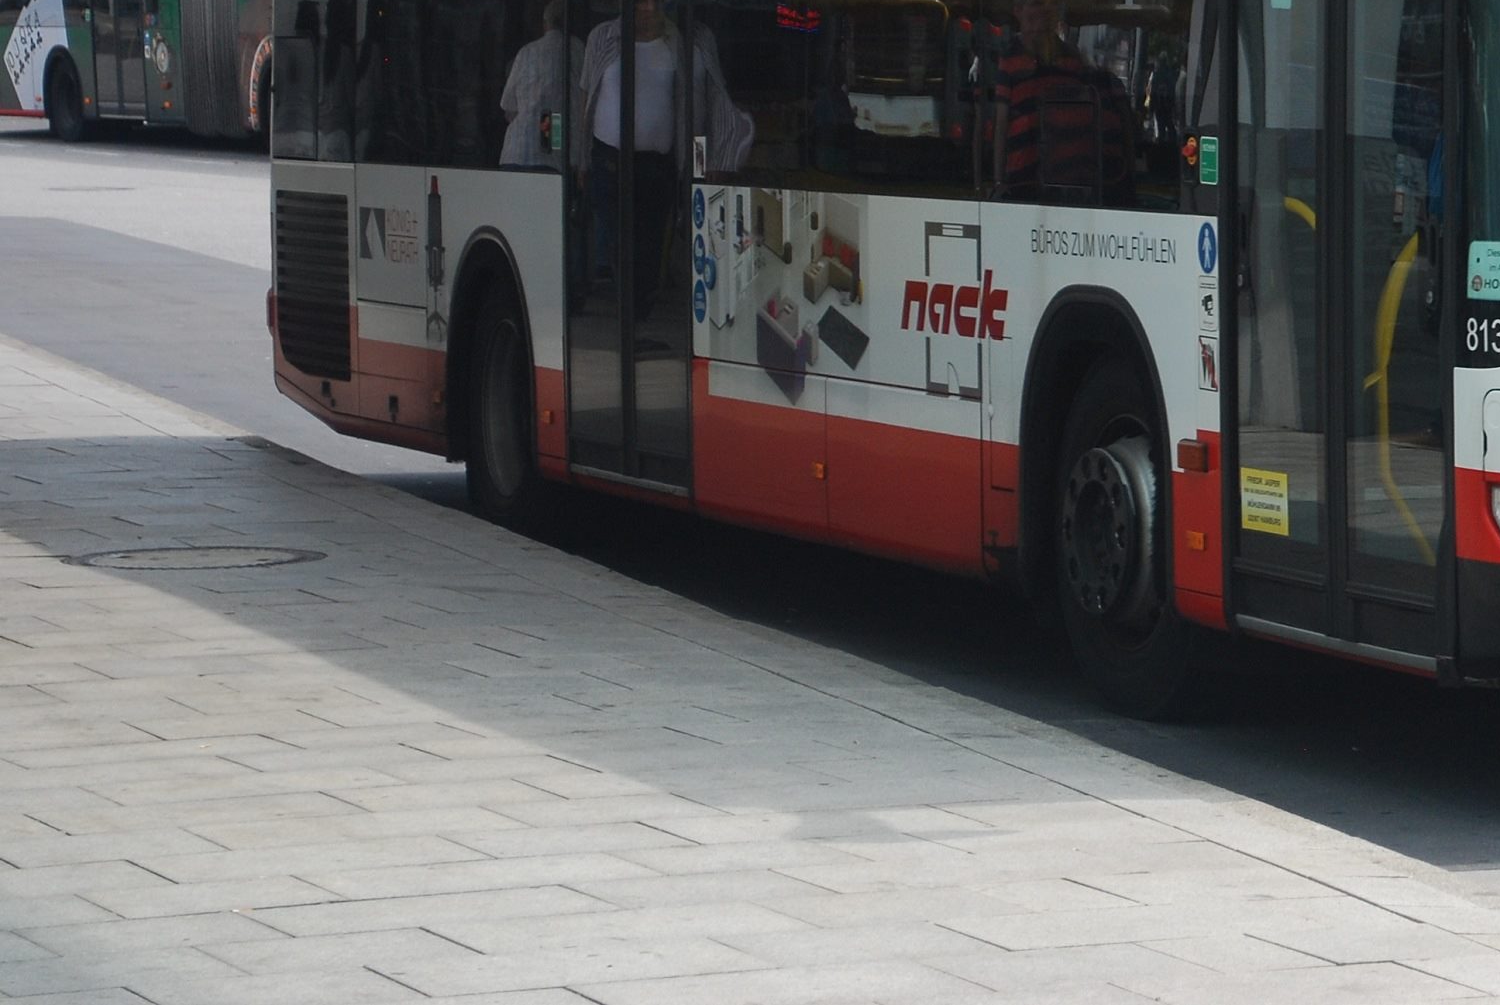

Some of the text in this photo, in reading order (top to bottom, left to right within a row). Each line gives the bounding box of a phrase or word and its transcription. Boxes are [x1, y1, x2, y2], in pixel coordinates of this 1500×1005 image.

[1031, 225, 1177, 264] BÜROS ZUM WOHLFÜHLEN
[900, 269, 1009, 341] nack
